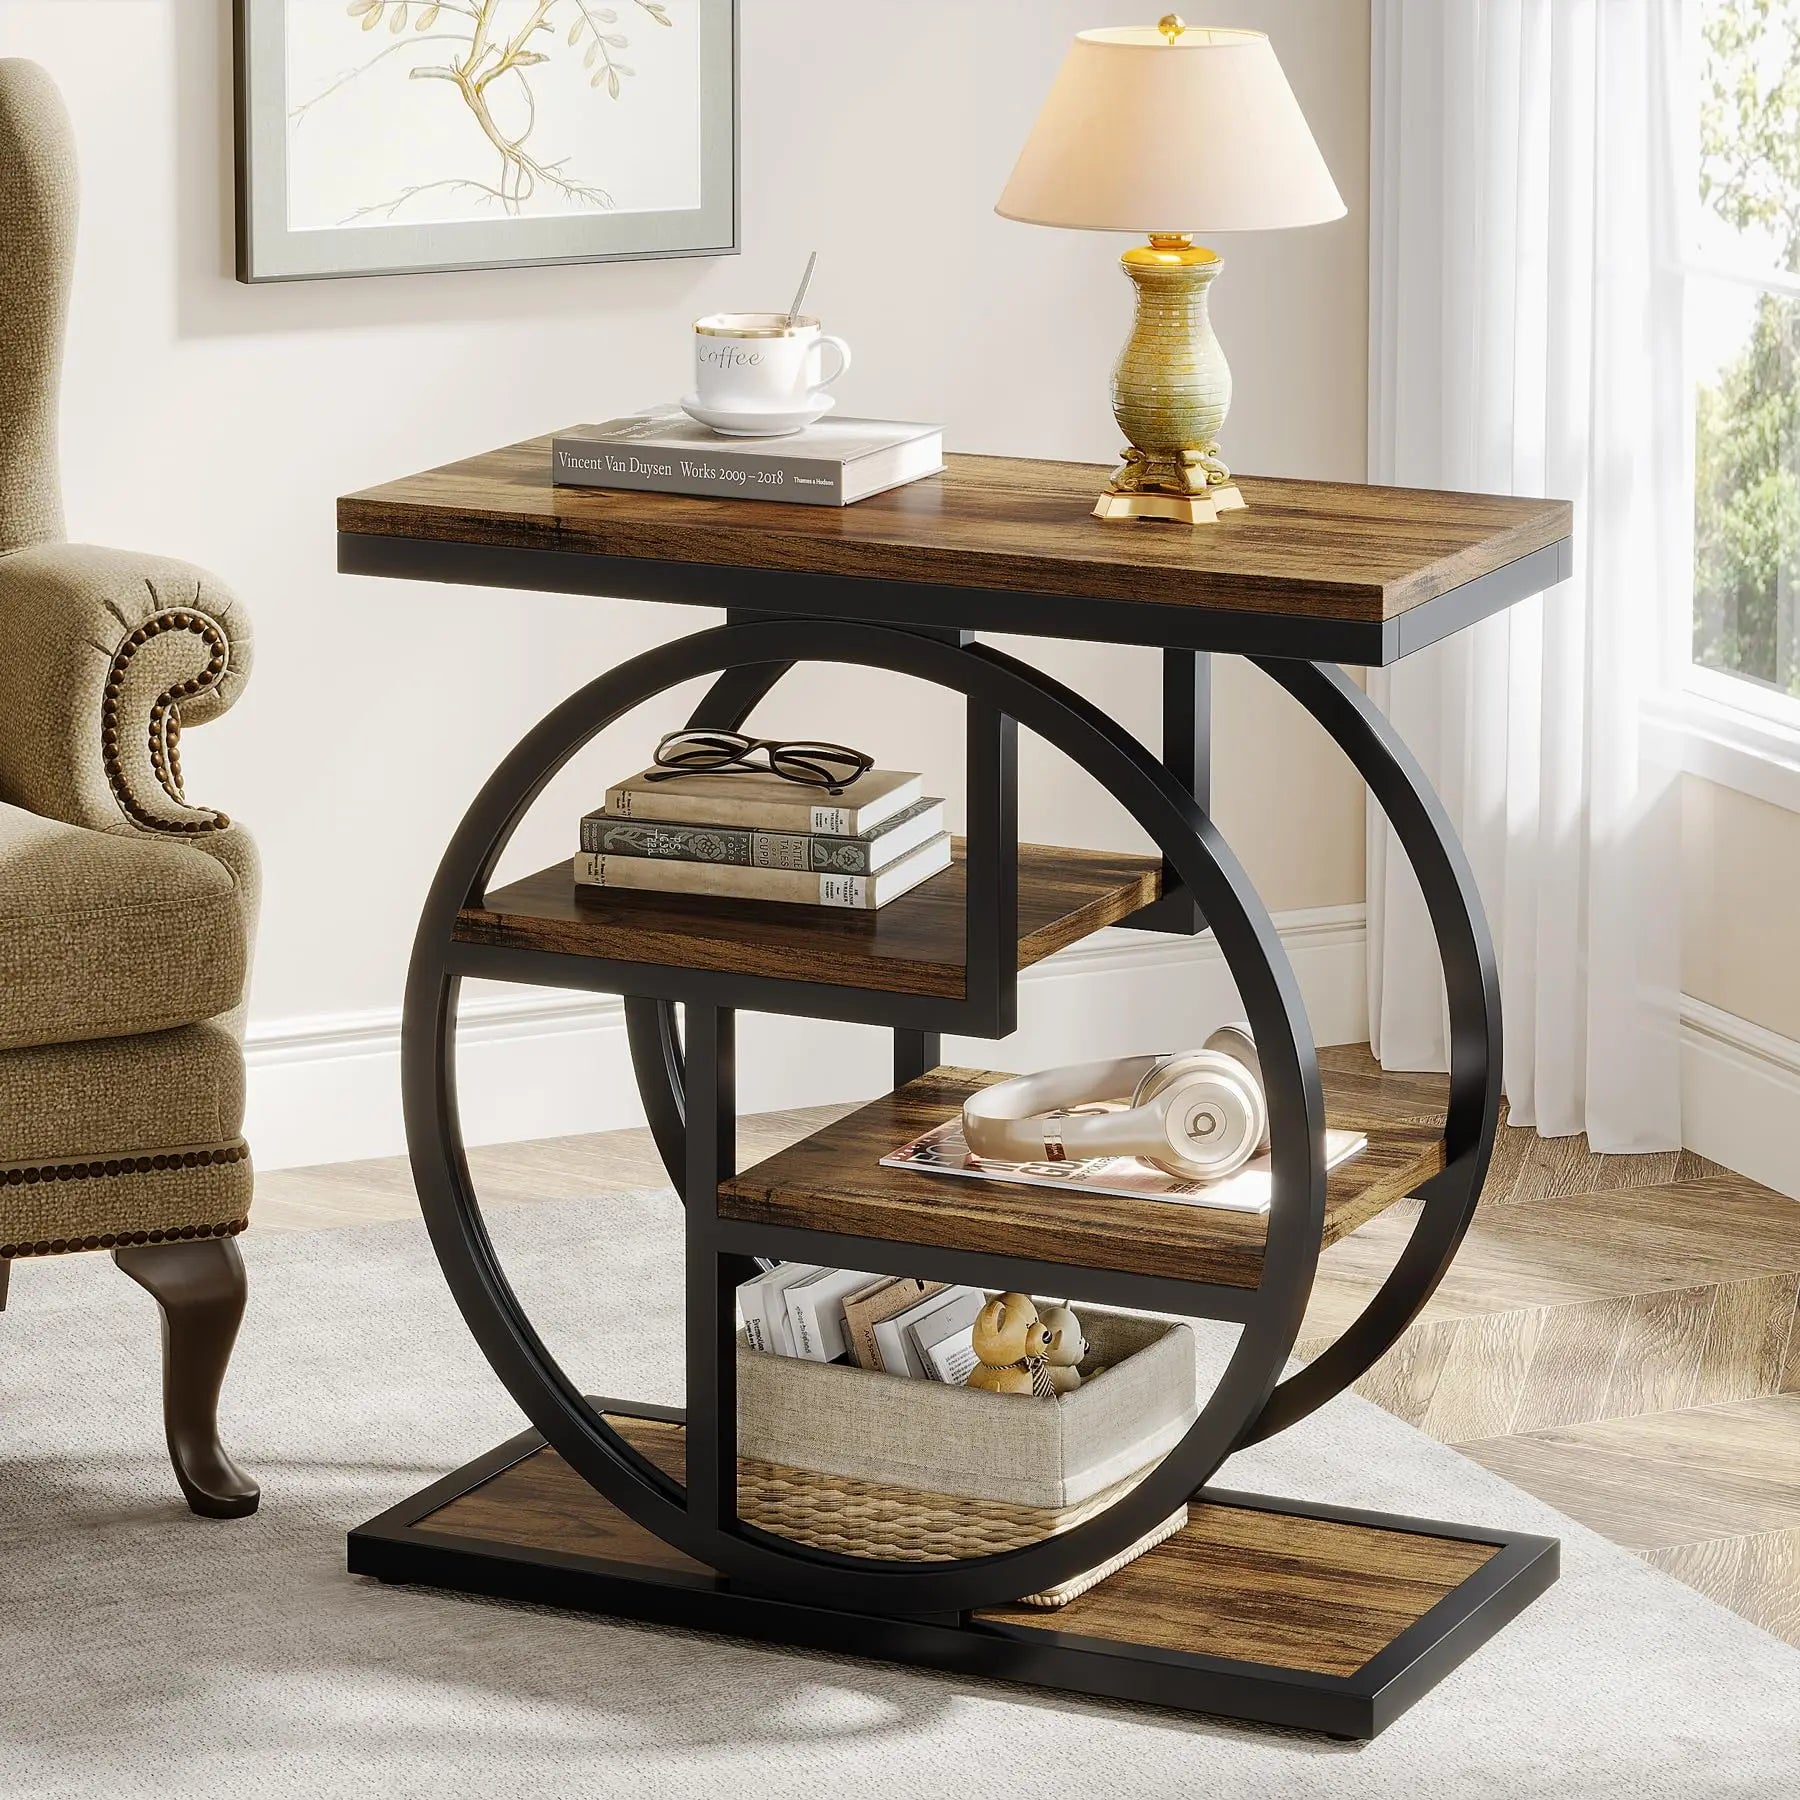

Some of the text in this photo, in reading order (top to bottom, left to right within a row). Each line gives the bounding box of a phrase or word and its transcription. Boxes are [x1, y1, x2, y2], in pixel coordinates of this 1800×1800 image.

[699, 344, 767, 369] Coffee
[558, 451, 602, 470] Vincent
[605, 455, 626, 472] Van
[629, 457, 673, 479] Duysen
[680, 461, 716, 479] Works
[759, 837, 769, 866] CUPID
[780, 839, 789, 869] TALES
[793, 840, 803, 870] TATTLE
